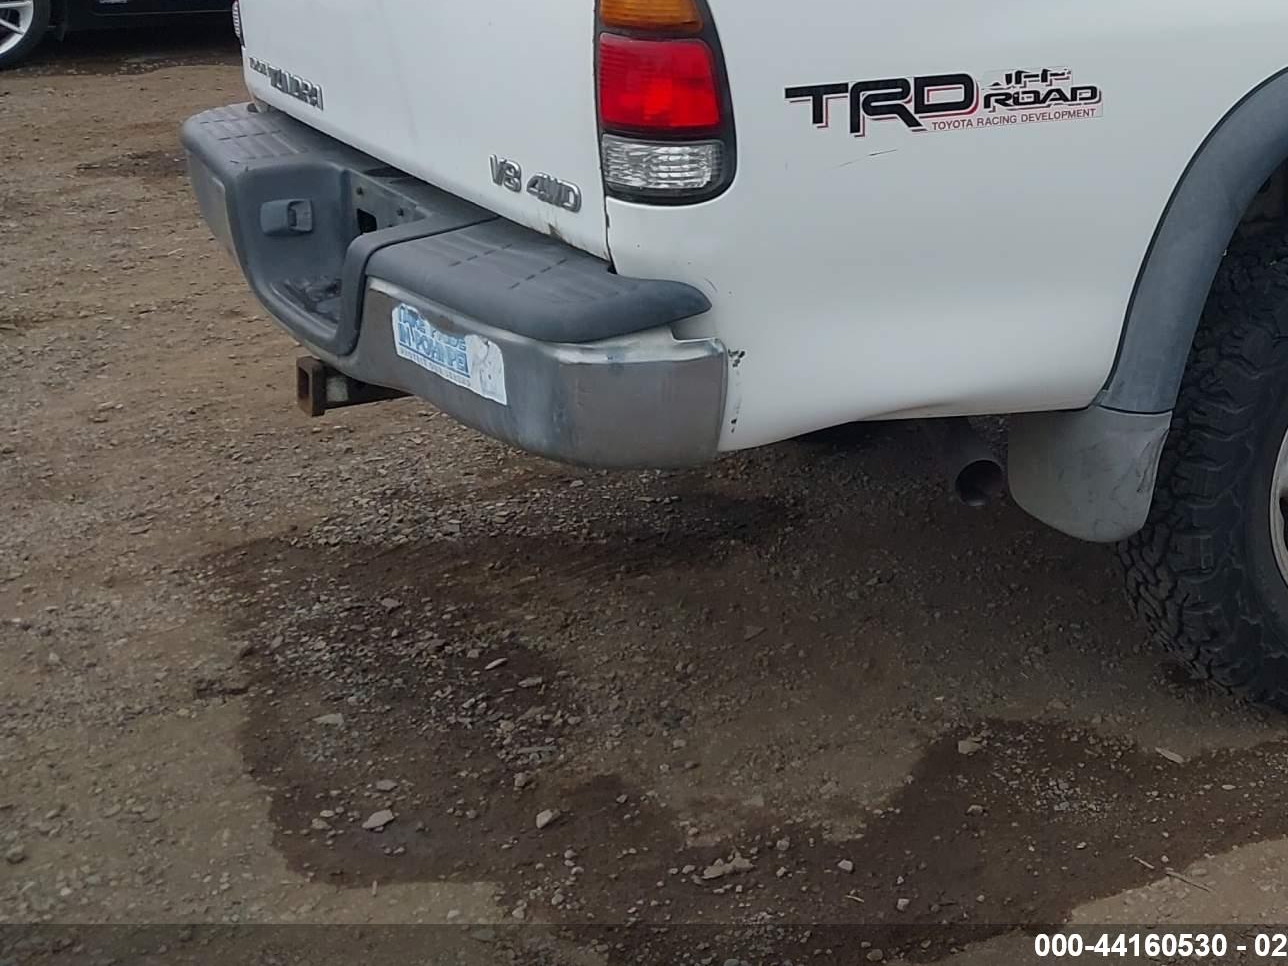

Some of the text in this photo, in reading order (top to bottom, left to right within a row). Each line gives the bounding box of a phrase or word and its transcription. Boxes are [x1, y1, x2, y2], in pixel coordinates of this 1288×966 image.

[785, 73, 978, 138] TRD
[984, 85, 1102, 113] ROAD
[932, 108, 1096, 131] TOYOTA RACING DEVELOPMENT
[490, 154, 521, 193] V8
